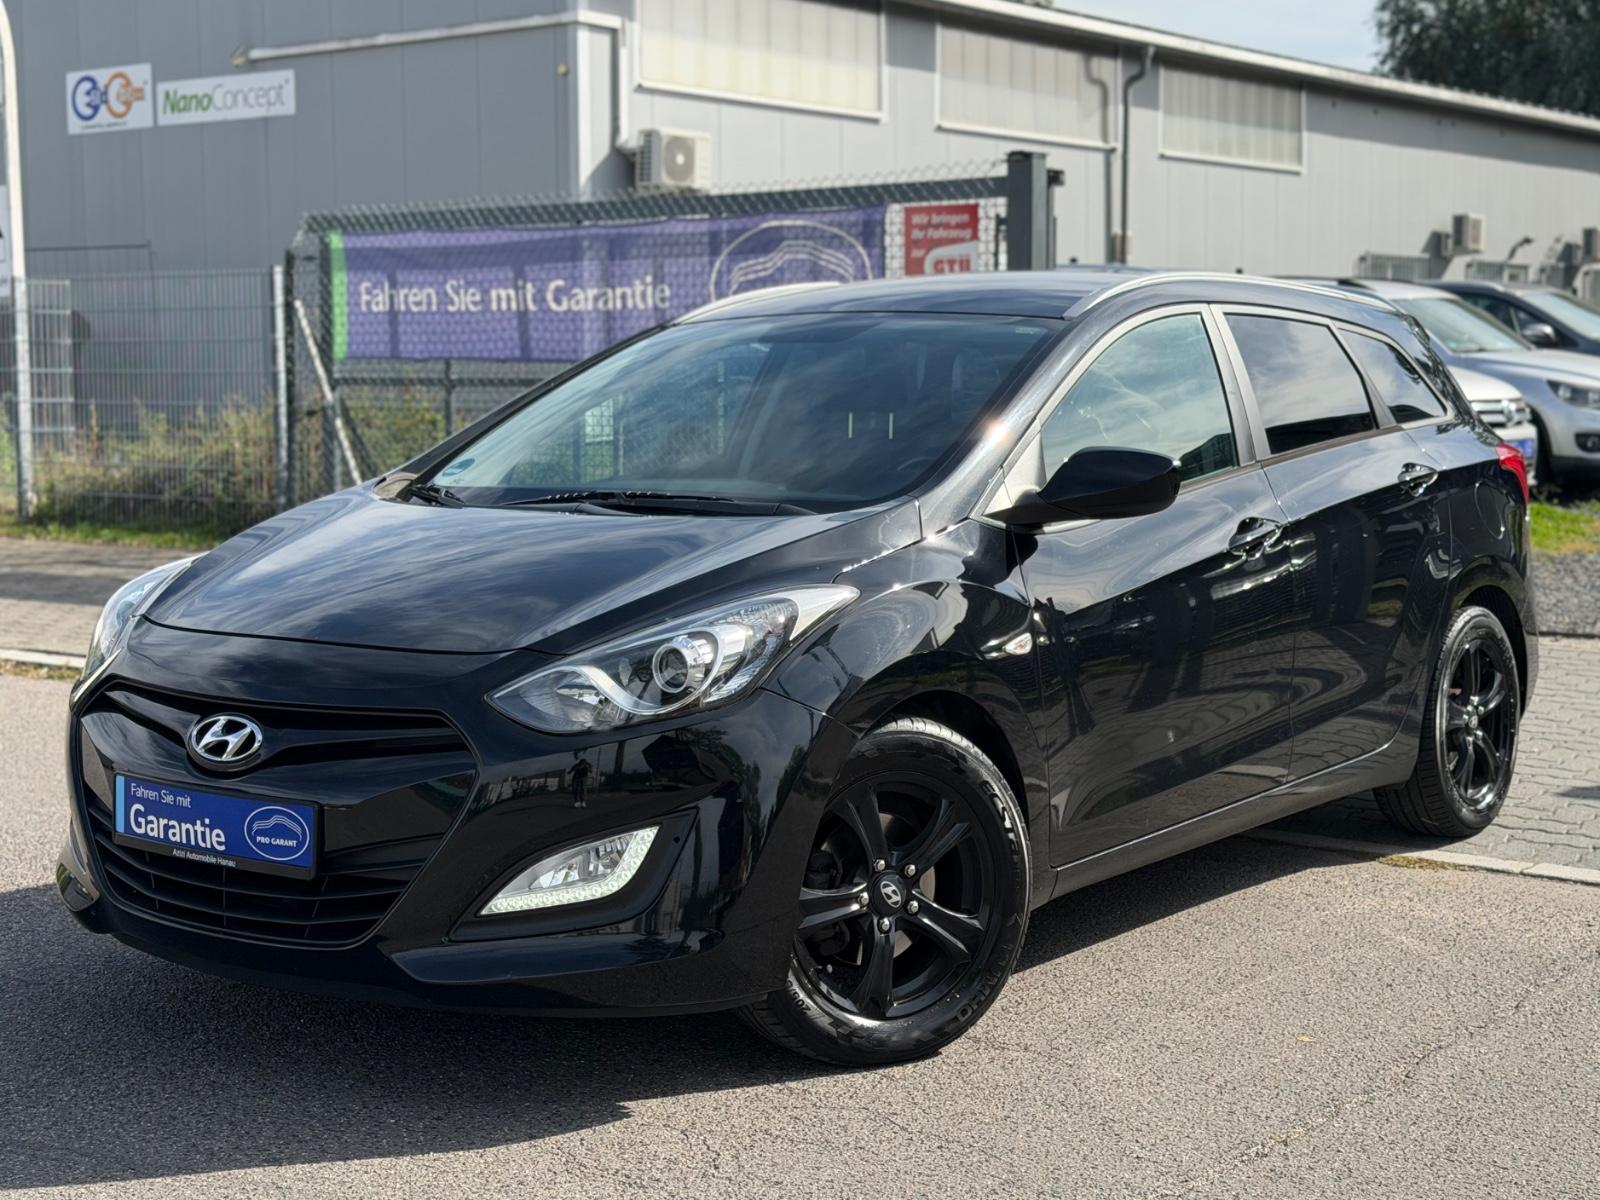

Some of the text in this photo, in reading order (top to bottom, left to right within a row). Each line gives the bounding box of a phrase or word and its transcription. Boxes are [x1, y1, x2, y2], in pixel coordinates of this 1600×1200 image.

[162, 82, 286, 115] NanoConcept
[360, 275, 672, 313] Fahren Sie mit Garantie
[130, 783, 192, 809] Fahren Sie mit
[129, 803, 227, 851] Garantie
[256, 836, 298, 848] PRO GARANT
